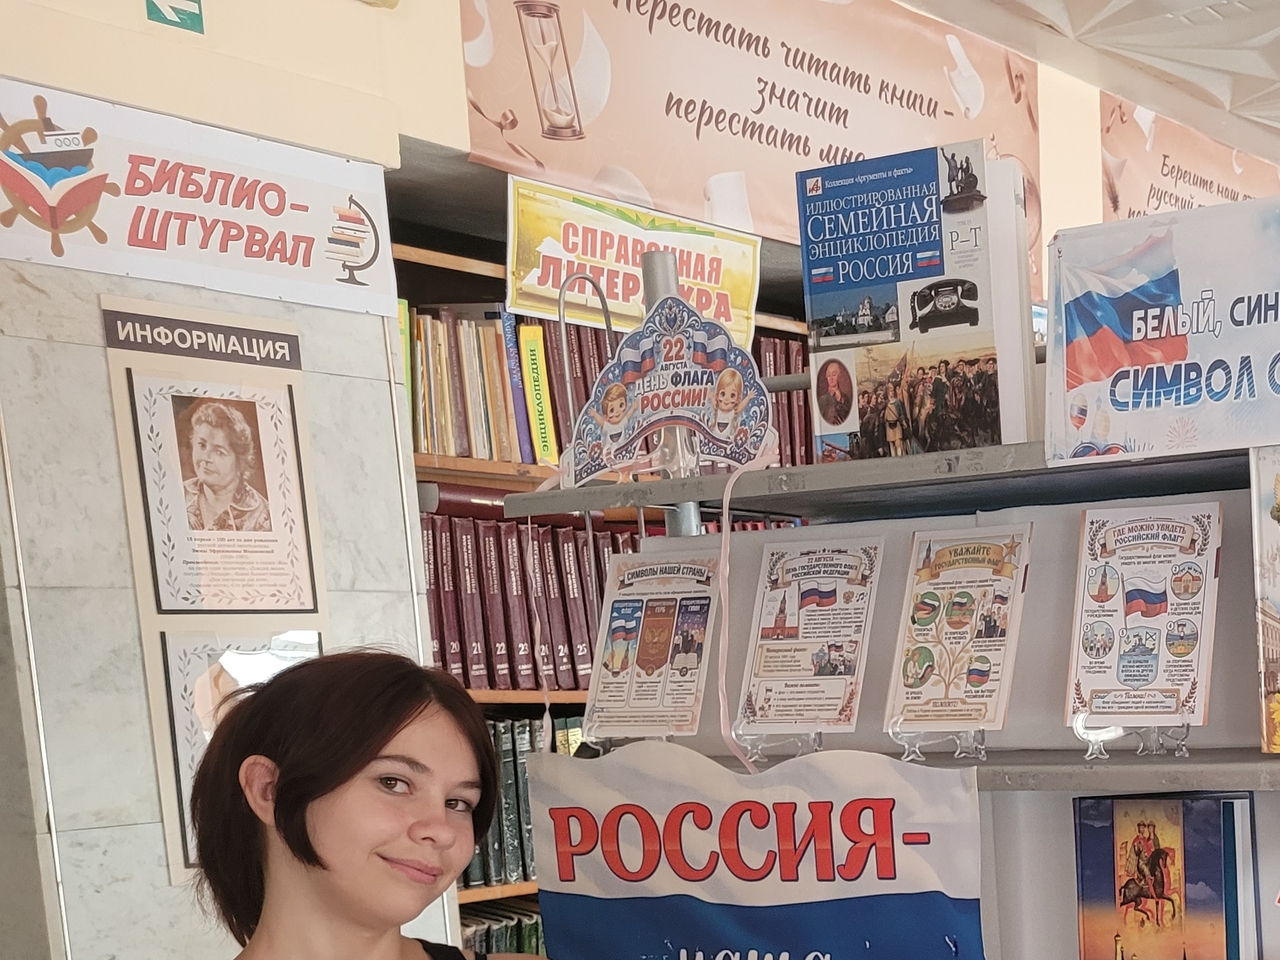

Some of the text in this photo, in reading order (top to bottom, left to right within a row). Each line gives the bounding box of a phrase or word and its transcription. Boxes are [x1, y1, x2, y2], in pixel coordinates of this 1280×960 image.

[780, 41, 872, 95] читать
[878, 78, 939, 120] книги
[750, 76, 850, 130] значит
[664, 91, 812, 157] перестать
[124, 154, 309, 217] БИБЛИО-
[825, 177, 855, 189] Коллекция
[1160, 154, 1240, 202] Берегите наш
[806, 181, 937, 215] ИЛЛЮСТРИРОВАННАЯ
[807, 195, 939, 242] СЕМЕЙНАЯ
[127, 205, 315, 268] ШТУРВАЛ
[561, 222, 723, 286] СПРАВНАЯ
[808, 224, 940, 261] ЭНЦИКЛОПЕДИЯ
[838, 251, 914, 284] РОССИЯ
[1131, 289, 1223, 341] БЕЛЫЙ,
[116, 320, 291, 361] ИНФОРМАЦИЯ
[662, 337, 685, 362] 22
[634, 369, 715, 397] ДЕНЬ ФЛАГА
[660, 361, 688, 372] АВГУСТА
[1109, 354, 1258, 414] СИМВОЛ
[640, 387, 708, 414] РОССИИ!
[1112, 522, 1187, 538] ГДЕ МОЖНО УВИДЕТЬ
[1114, 532, 1184, 546] РОССИЙСКИЙ ФЛАГ?
[626, 564, 707, 582] СИМВОЛЫ НАШЕЙ СТРАНЫ
[472, 643, 482, 654] 21
[496, 643, 507, 654] 22
[519, 643, 529, 655] 23
[549, 797, 931, 883] РОССИЯ-
